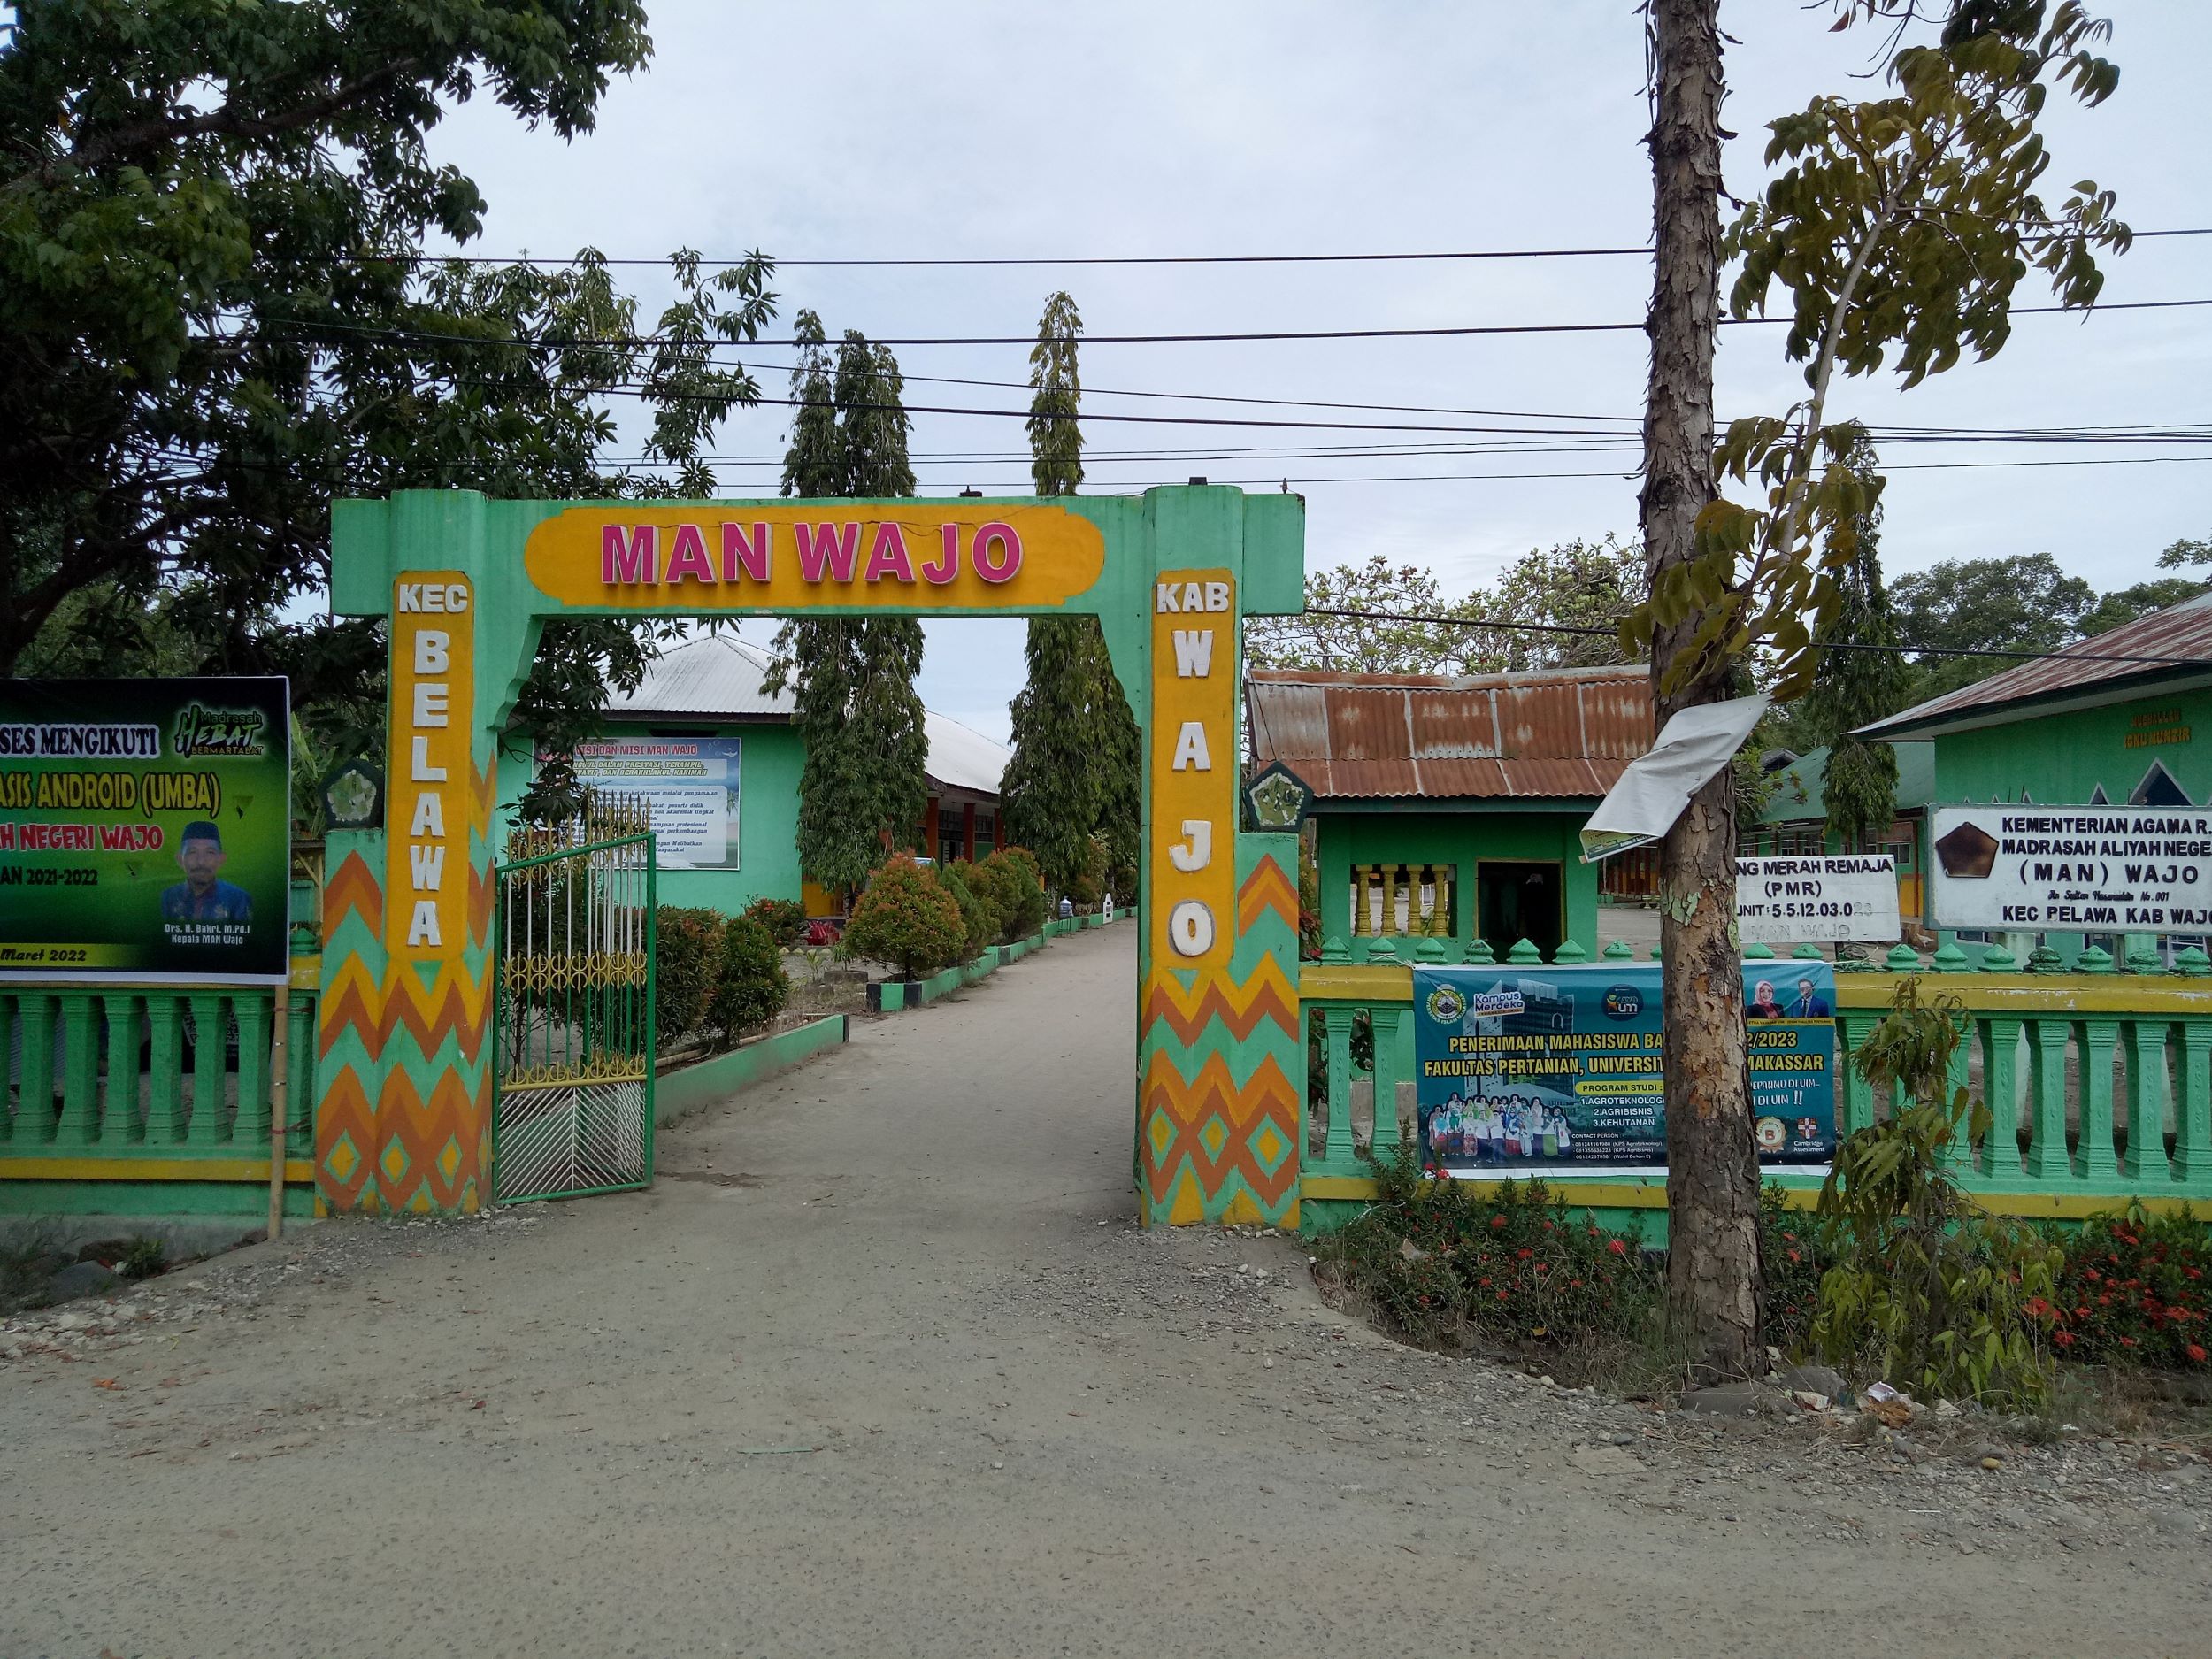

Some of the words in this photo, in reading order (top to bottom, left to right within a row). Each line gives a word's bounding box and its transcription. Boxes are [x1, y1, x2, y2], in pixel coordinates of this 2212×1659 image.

[602, 523, 772, 585] MAN
[795, 523, 1025, 586] WAJO
[399, 584, 468, 613] KEC
[1156, 582, 1229, 613] KAB
[200, 711, 262, 724] Madrasah
[41, 727, 157, 756] MENGIKUTI
[599, 745, 619, 755] DAN
[620, 745, 644, 755] MISI
[647, 745, 669, 755] MAN
[671, 745, 697, 755] WAJO
[191, 746, 264, 755] BERMARTABAT
[38, 772, 136, 810] ANDROID
[142, 772, 221, 819] (UMBA)
[407, 629, 449, 947] BELAWA
[1169, 629, 1215, 957] WAJO
[2002, 817, 2127, 833] KEMENTERIAN
[2131, 818, 2193, 834] AGAMA
[19, 824, 96, 850] NEGERI
[99, 824, 164, 851] WAJO
[2002, 839, 2096, 856] MADRASAH
[2100, 841, 2161, 856] ALIYAH
[1, 866, 23, 885] AN
[27, 869, 98, 885] 2021-2022
[1764, 860, 1822, 875] MERAH
[1825, 859, 1893, 873] REMAJA
[2124, 864, 2199, 884] WAJO
[2063, 890, 2089, 901] Sultan
[2002, 906, 2039, 921] KEC
[2126, 908, 2164, 924] KAB
[2170, 908, 2212, 925] WAJ
[165, 923, 183, 933] Drs.
[172, 934, 199, 944] Kepala
[202, 935, 220, 944] MAN
[223, 935, 243, 945] Wajo
[1, 948, 44, 961] Maret
[50, 949, 87, 962] 2022
[1475, 992, 1520, 1005] Kampus
[1475, 1001, 1524, 1012] Merdeka
[1449, 1036, 1545, 1053] PENERIMAAN
[1549, 1034, 1640, 1051] MAHASISWA
[1425, 1060, 1494, 1076] FAKULTAS
[1498, 1058, 1584, 1076] PERTANIAN,
[1787, 1079, 1798, 1088] DI
[1758, 1095, 1769, 1106] DI
[1771, 1094, 1789, 1105] UIM
[1593, 1118, 1655, 1127] 3.KEHUTANAN
[1764, 1129, 1776, 1141] B
